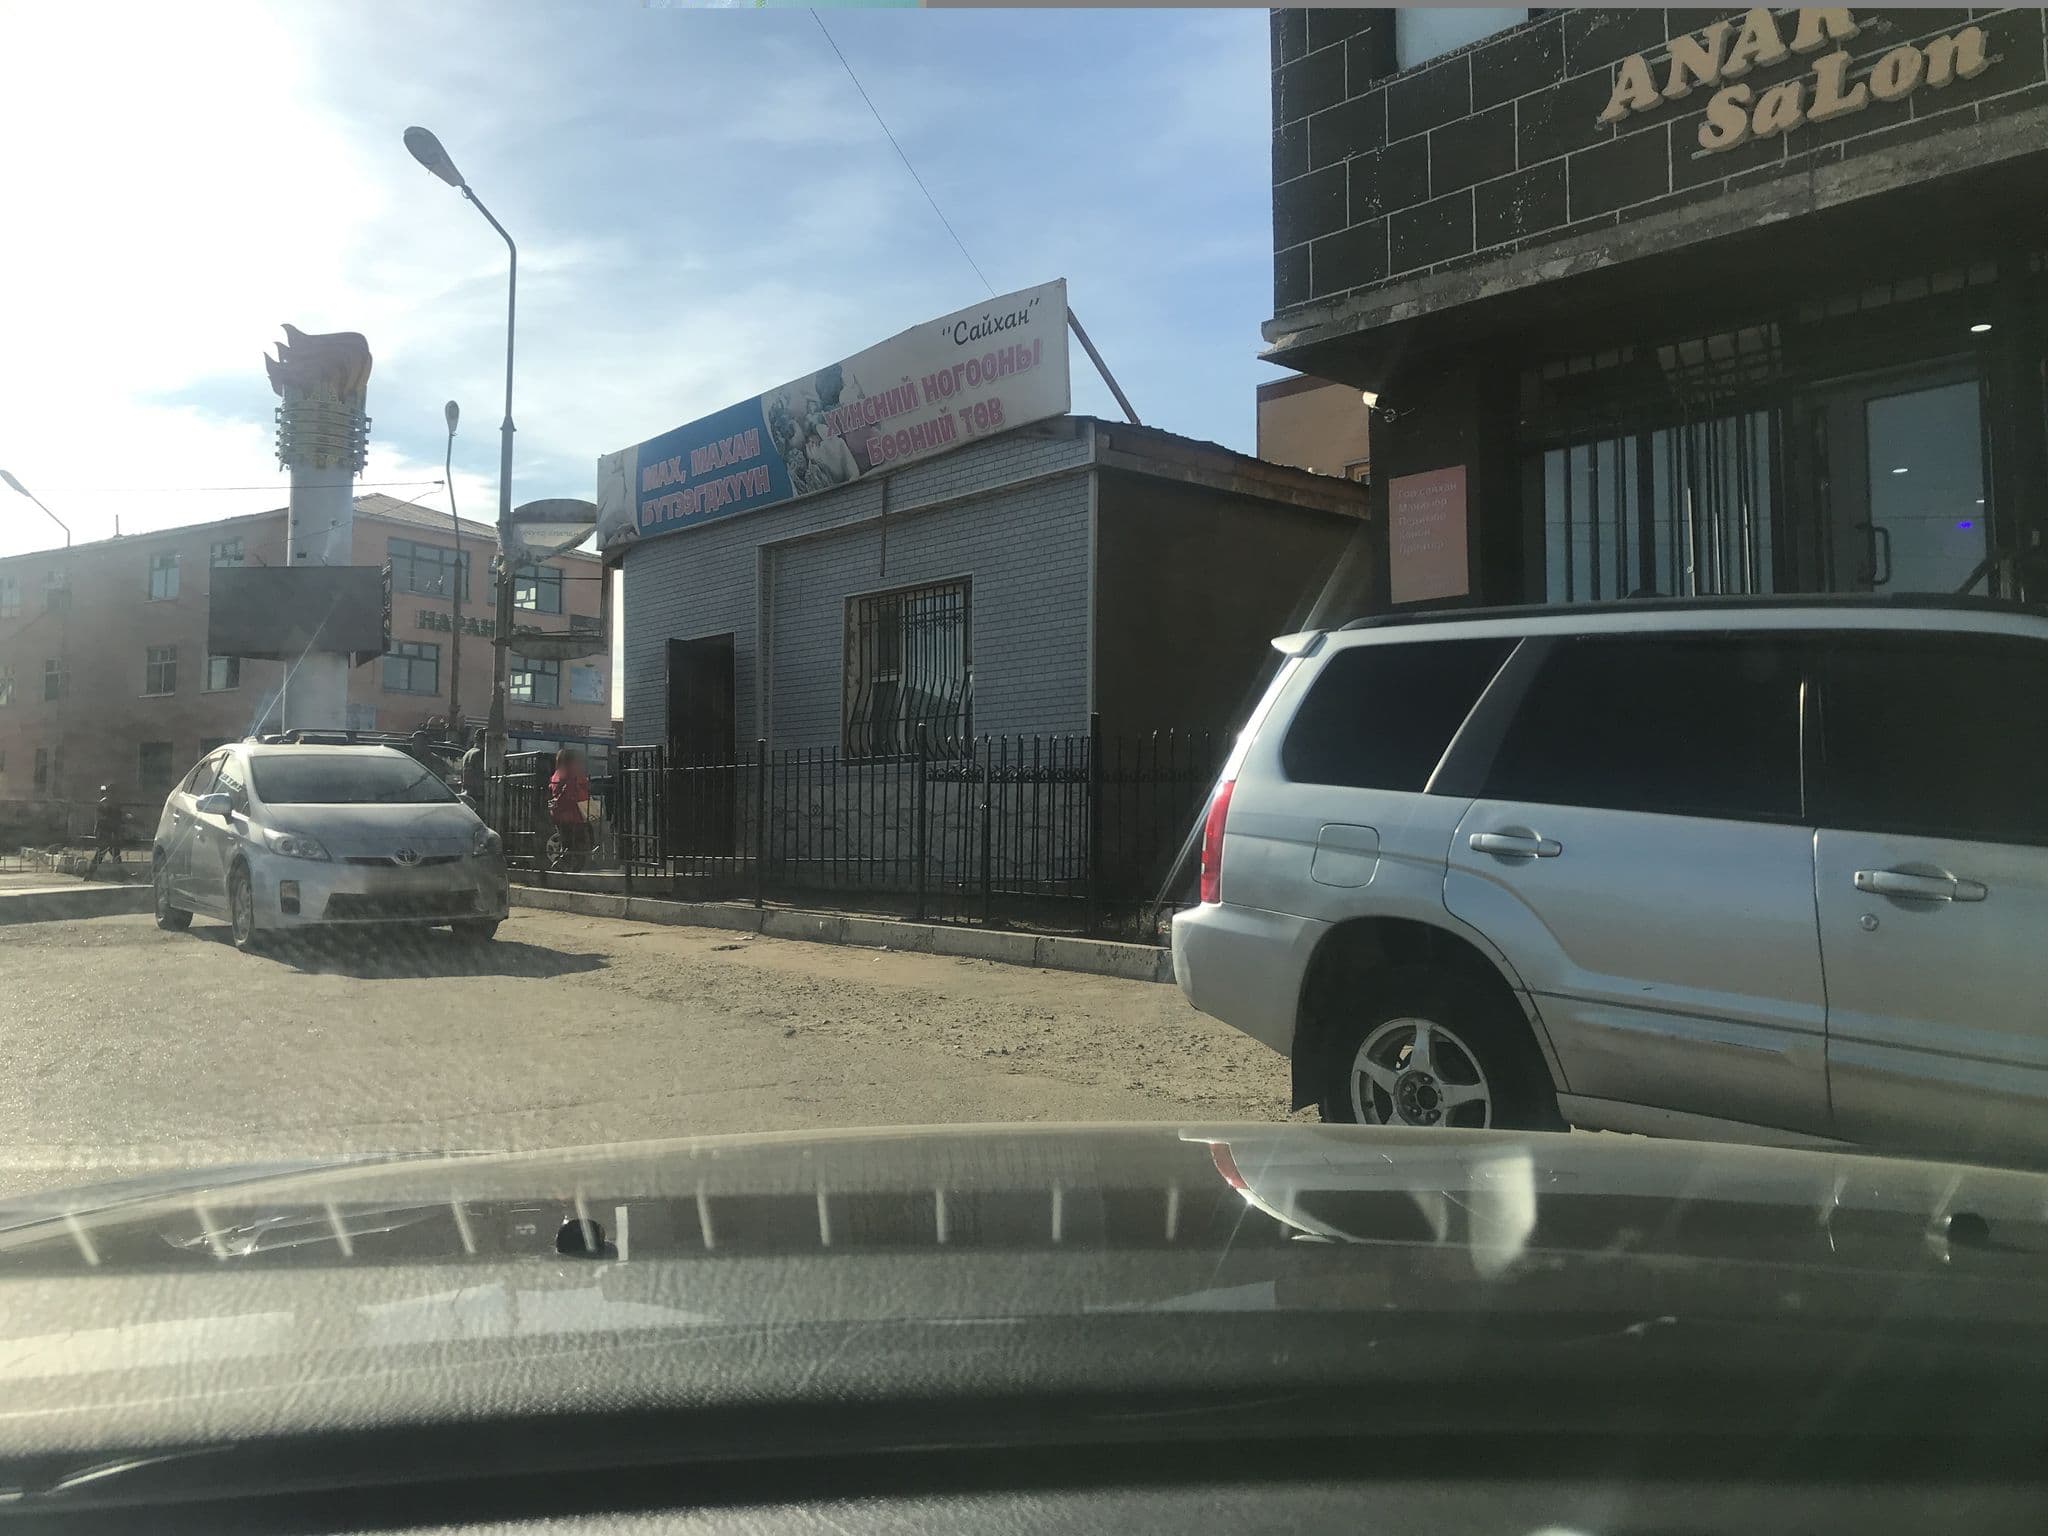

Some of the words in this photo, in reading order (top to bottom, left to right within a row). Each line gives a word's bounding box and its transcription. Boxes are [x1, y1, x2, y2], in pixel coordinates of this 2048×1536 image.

[921, 340, 1041, 401] НОГООНЫ
[691, 429, 760, 477] МАХАН
[866, 408, 955, 466] БӨӨНИЙ
[959, 398, 1006, 436] ТӨВ
